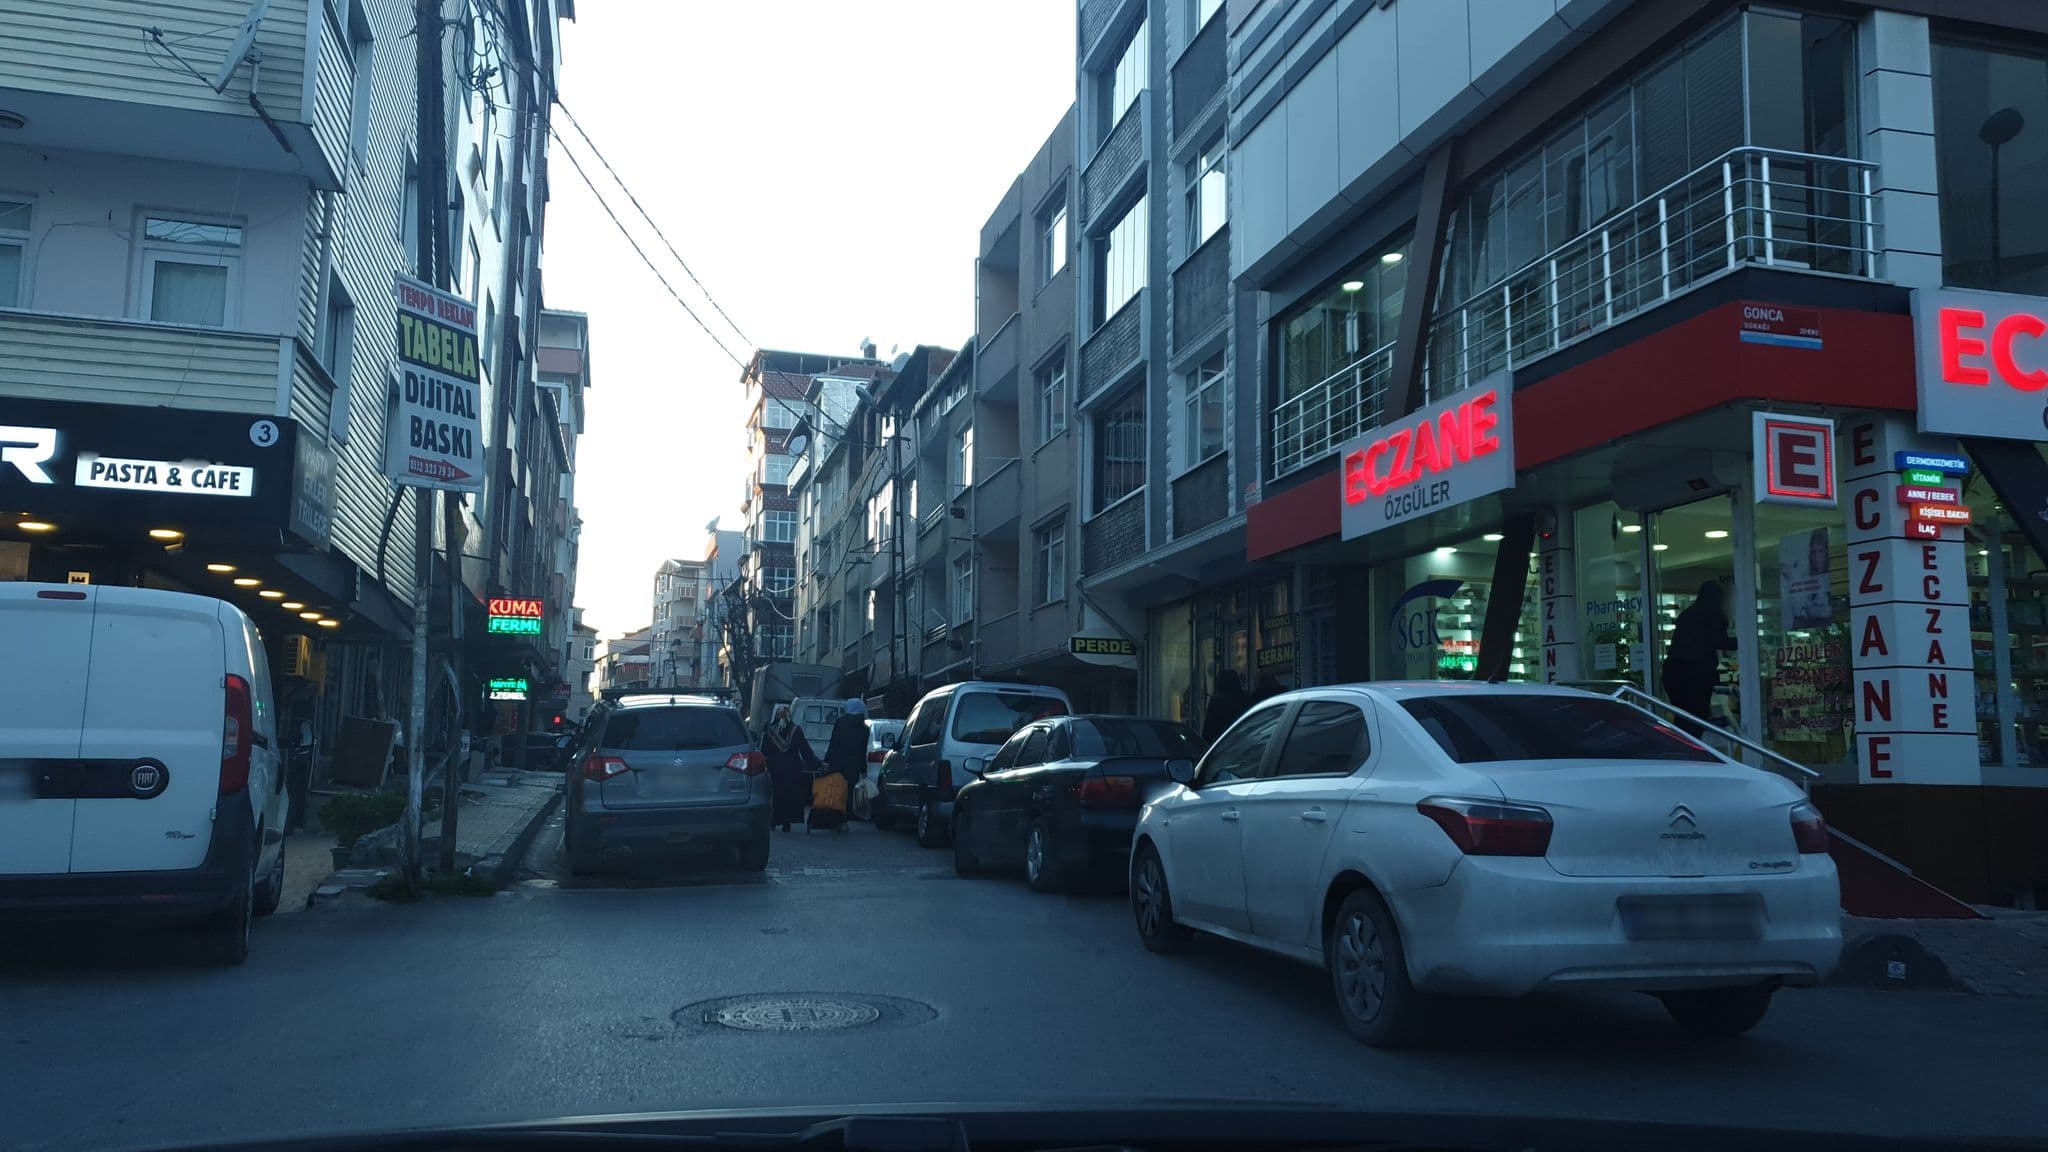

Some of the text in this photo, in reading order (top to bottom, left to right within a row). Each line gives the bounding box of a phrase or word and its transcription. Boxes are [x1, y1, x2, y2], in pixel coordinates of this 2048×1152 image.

[399, 284, 475, 330] TEMPO REKLAM
[1743, 306, 1784, 322] GONCA
[400, 314, 477, 378] TABELA
[410, 414, 472, 459] BASKI
[1345, 389, 1499, 506] ECZANE
[90, 461, 241, 491] PASTA & CAFE
[1778, 432, 1819, 488] E
[1911, 471, 1941, 484] VİTAMİN
[1384, 479, 1450, 520] ÖZGÜLER
[1907, 489, 1927, 500] ANNE
[1931, 490, 1955, 502] BEBEK
[1918, 522, 1937, 536] İLAÇ
[1586, 597, 1642, 617] Pharmacy
[1853, 423, 1892, 778] ECZANE
[1075, 639, 1132, 654] PERDE
[1398, 608, 1443, 650] SGK
[1922, 545, 1949, 729] ECZANE
[137, 773, 154, 785] FIAT
